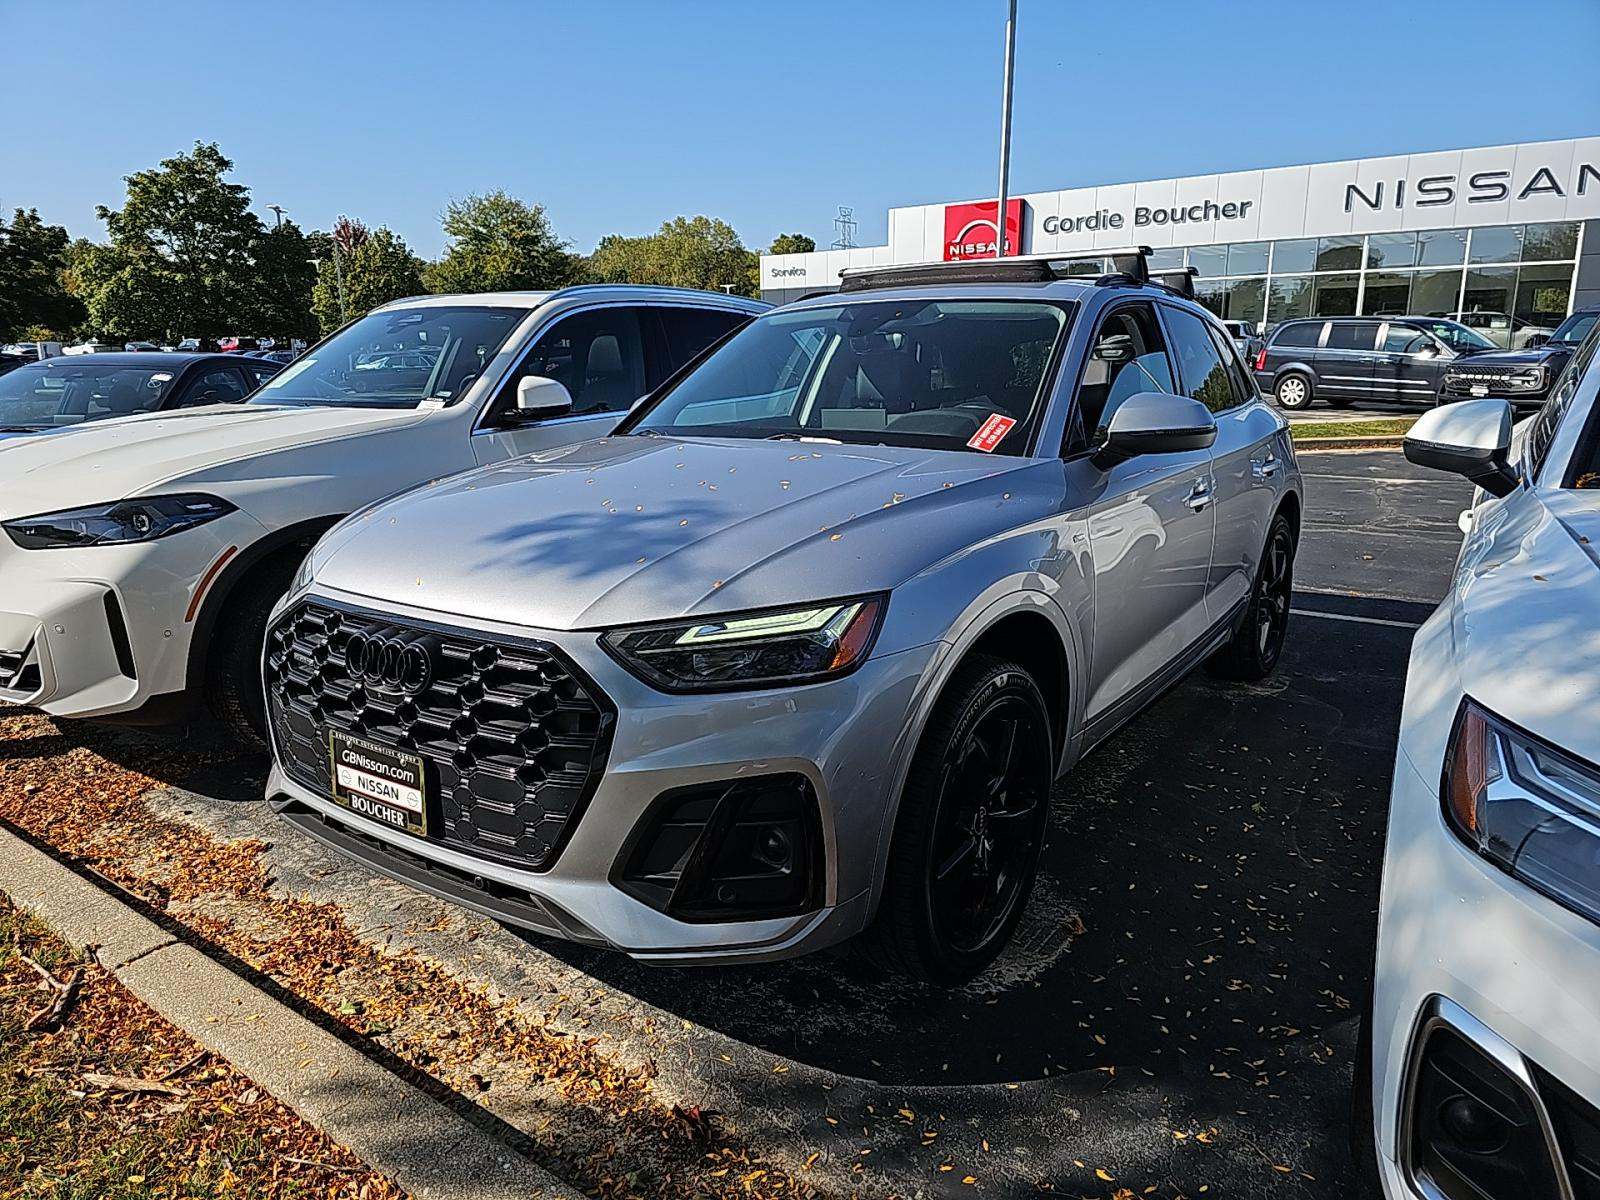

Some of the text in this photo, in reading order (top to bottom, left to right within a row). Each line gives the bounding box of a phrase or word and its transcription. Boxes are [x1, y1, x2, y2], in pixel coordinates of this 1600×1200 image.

[1043, 199, 1252, 235] Gordie Boucher
[341, 749, 415, 784] GBNissan.com
[357, 775, 400, 801] NISSAN
[351, 794, 405, 827] BOUCHER
